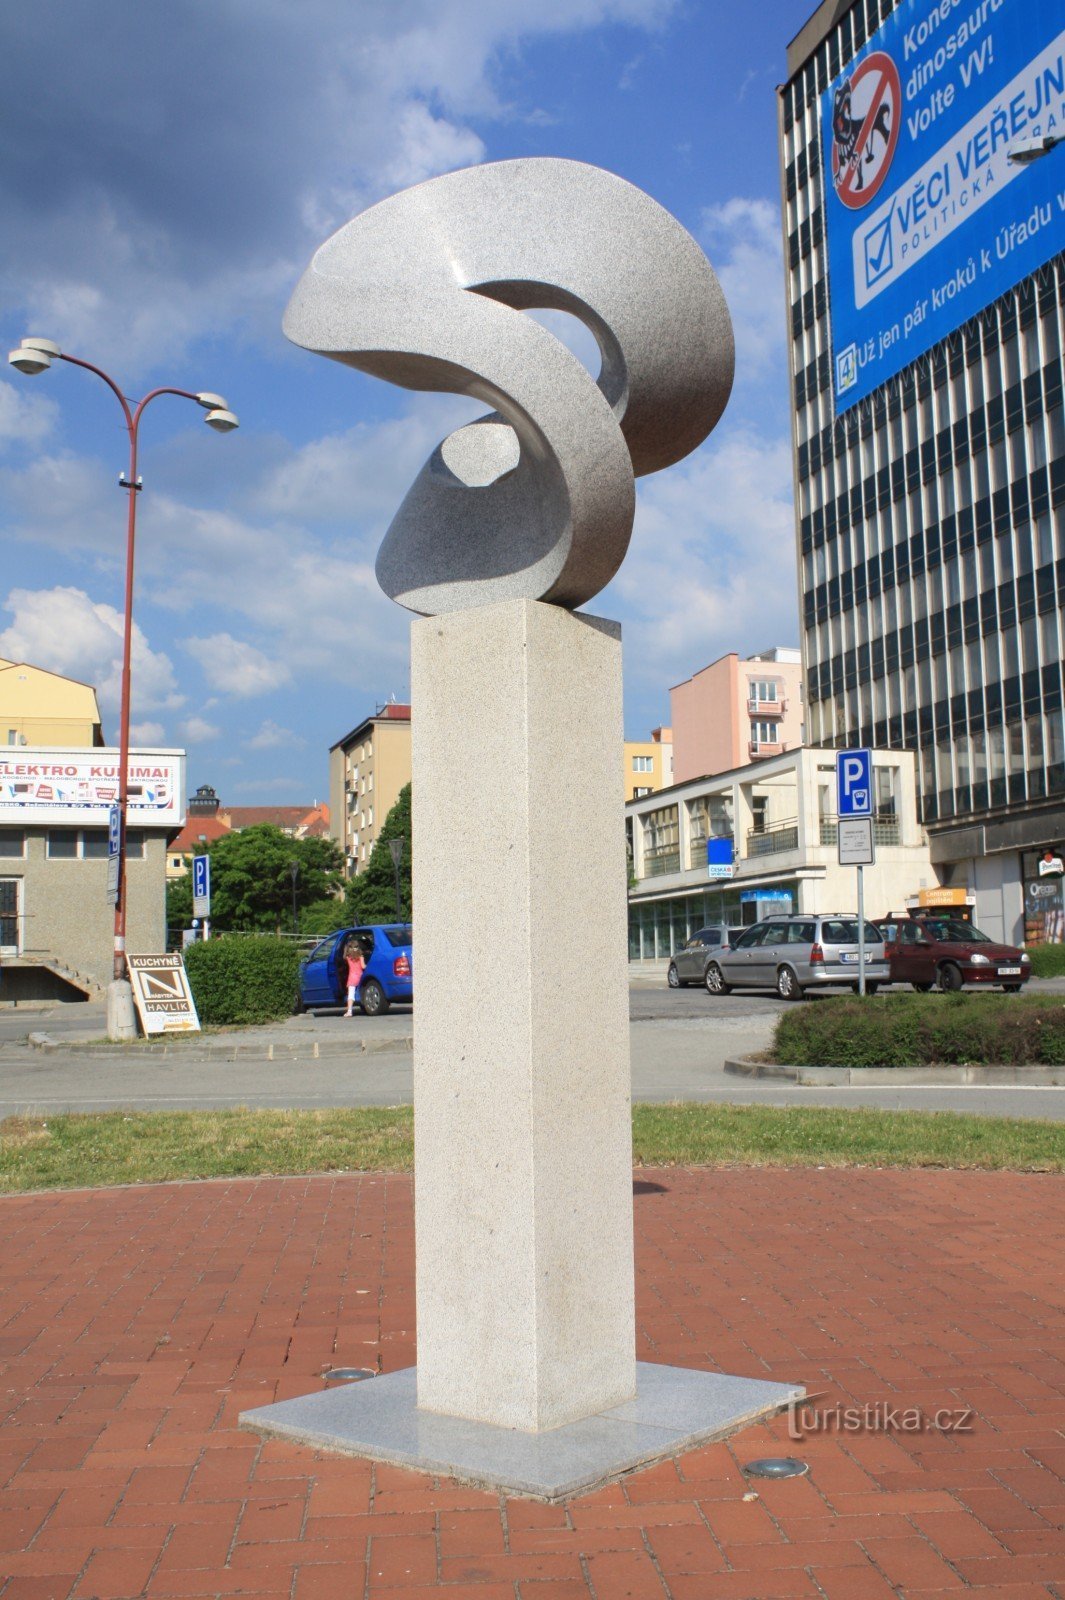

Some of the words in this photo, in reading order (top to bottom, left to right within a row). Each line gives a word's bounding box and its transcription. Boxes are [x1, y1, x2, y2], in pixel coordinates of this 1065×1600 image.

[907, 83, 955, 141] Volte
[959, 34, 994, 89] VV!
[897, 163, 950, 235] VĚCI
[902, 167, 994, 260] POLITICKÁ
[858, 337, 876, 368] Už
[879, 322, 900, 360] jen
[903, 299, 929, 338] pár
[931, 257, 976, 312] kroků
[981, 248, 992, 274] k
[995, 201, 1052, 260] Úřadu
[90, 766, 169, 778] KUIMAI
[844, 758, 864, 796] P
[196, 861, 204, 885] P
[926, 890, 953, 898] Centrum
[132, 957, 180, 967] KUCHYNĚ
[147, 1001, 188, 1012] HAVLÍK
